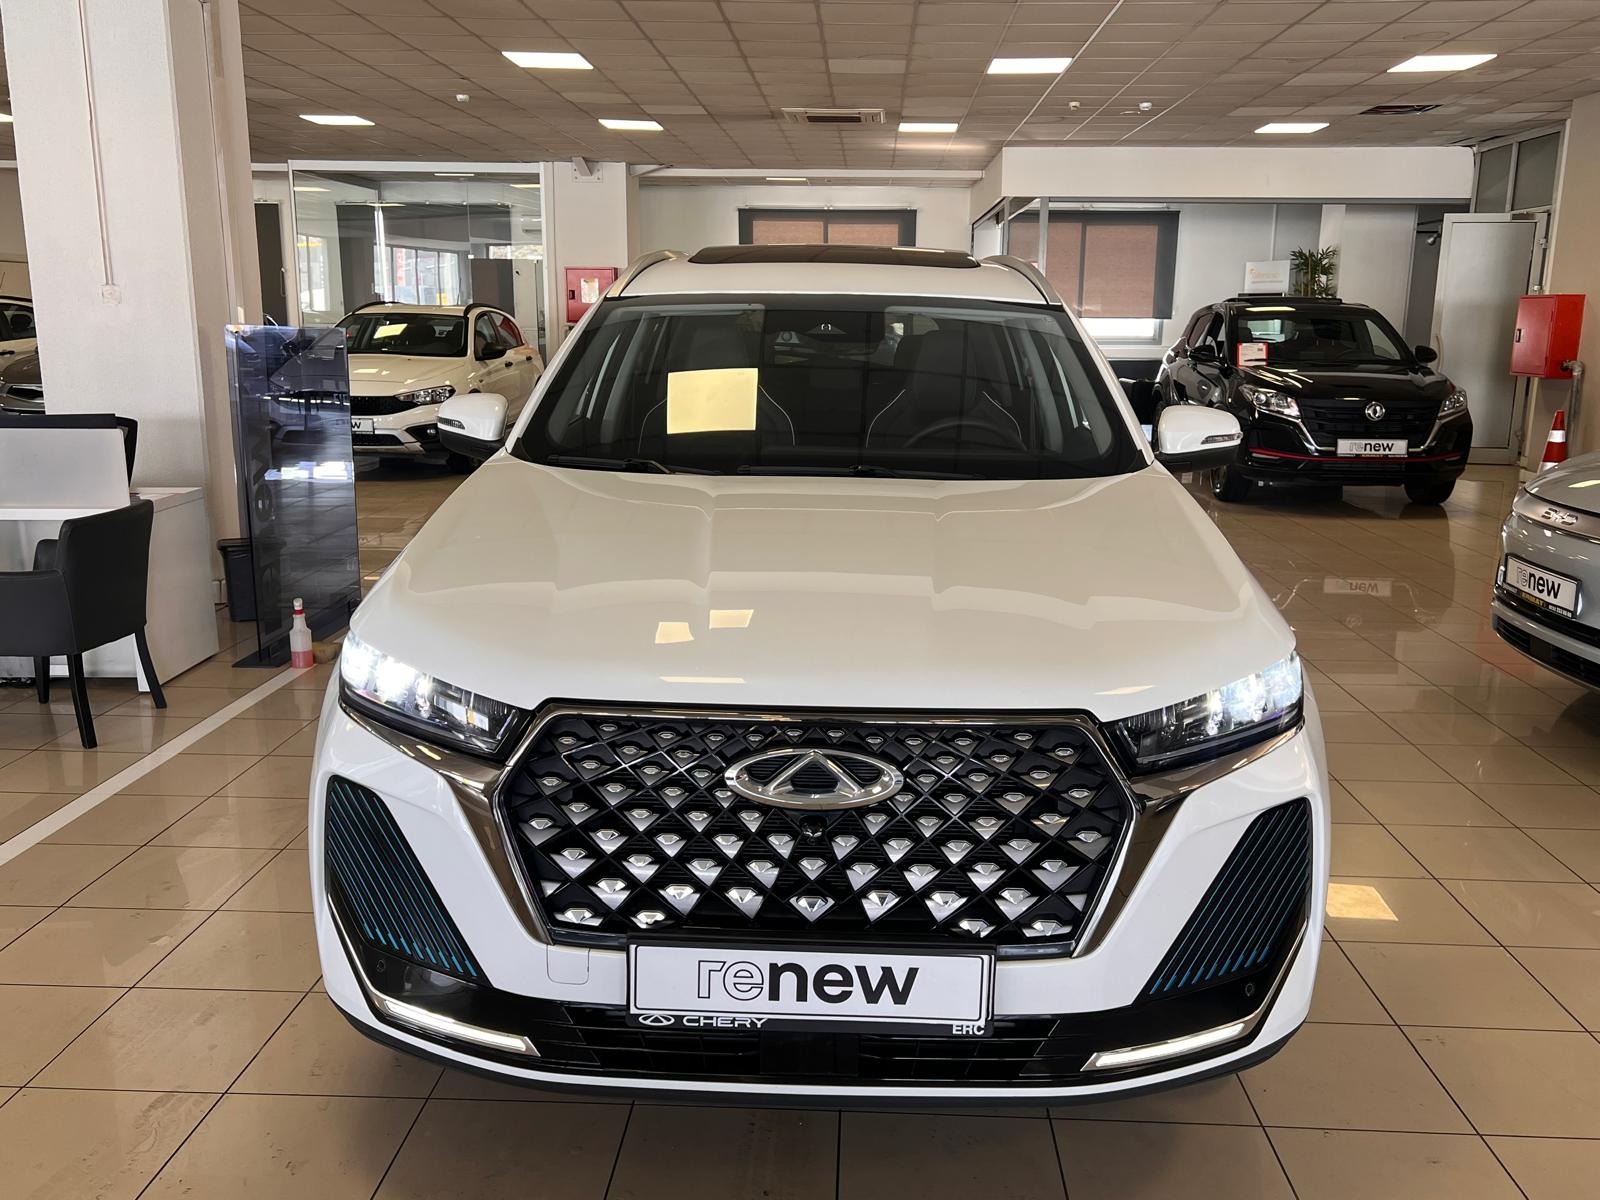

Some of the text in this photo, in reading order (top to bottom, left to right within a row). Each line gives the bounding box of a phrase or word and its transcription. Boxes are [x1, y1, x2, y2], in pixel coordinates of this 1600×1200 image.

[1349, 441, 1394, 452] renew
[1517, 566, 1561, 599] renew
[697, 960, 919, 1006] renew
[682, 1016, 768, 1029] CHERY
[952, 1024, 985, 1036] ERC
